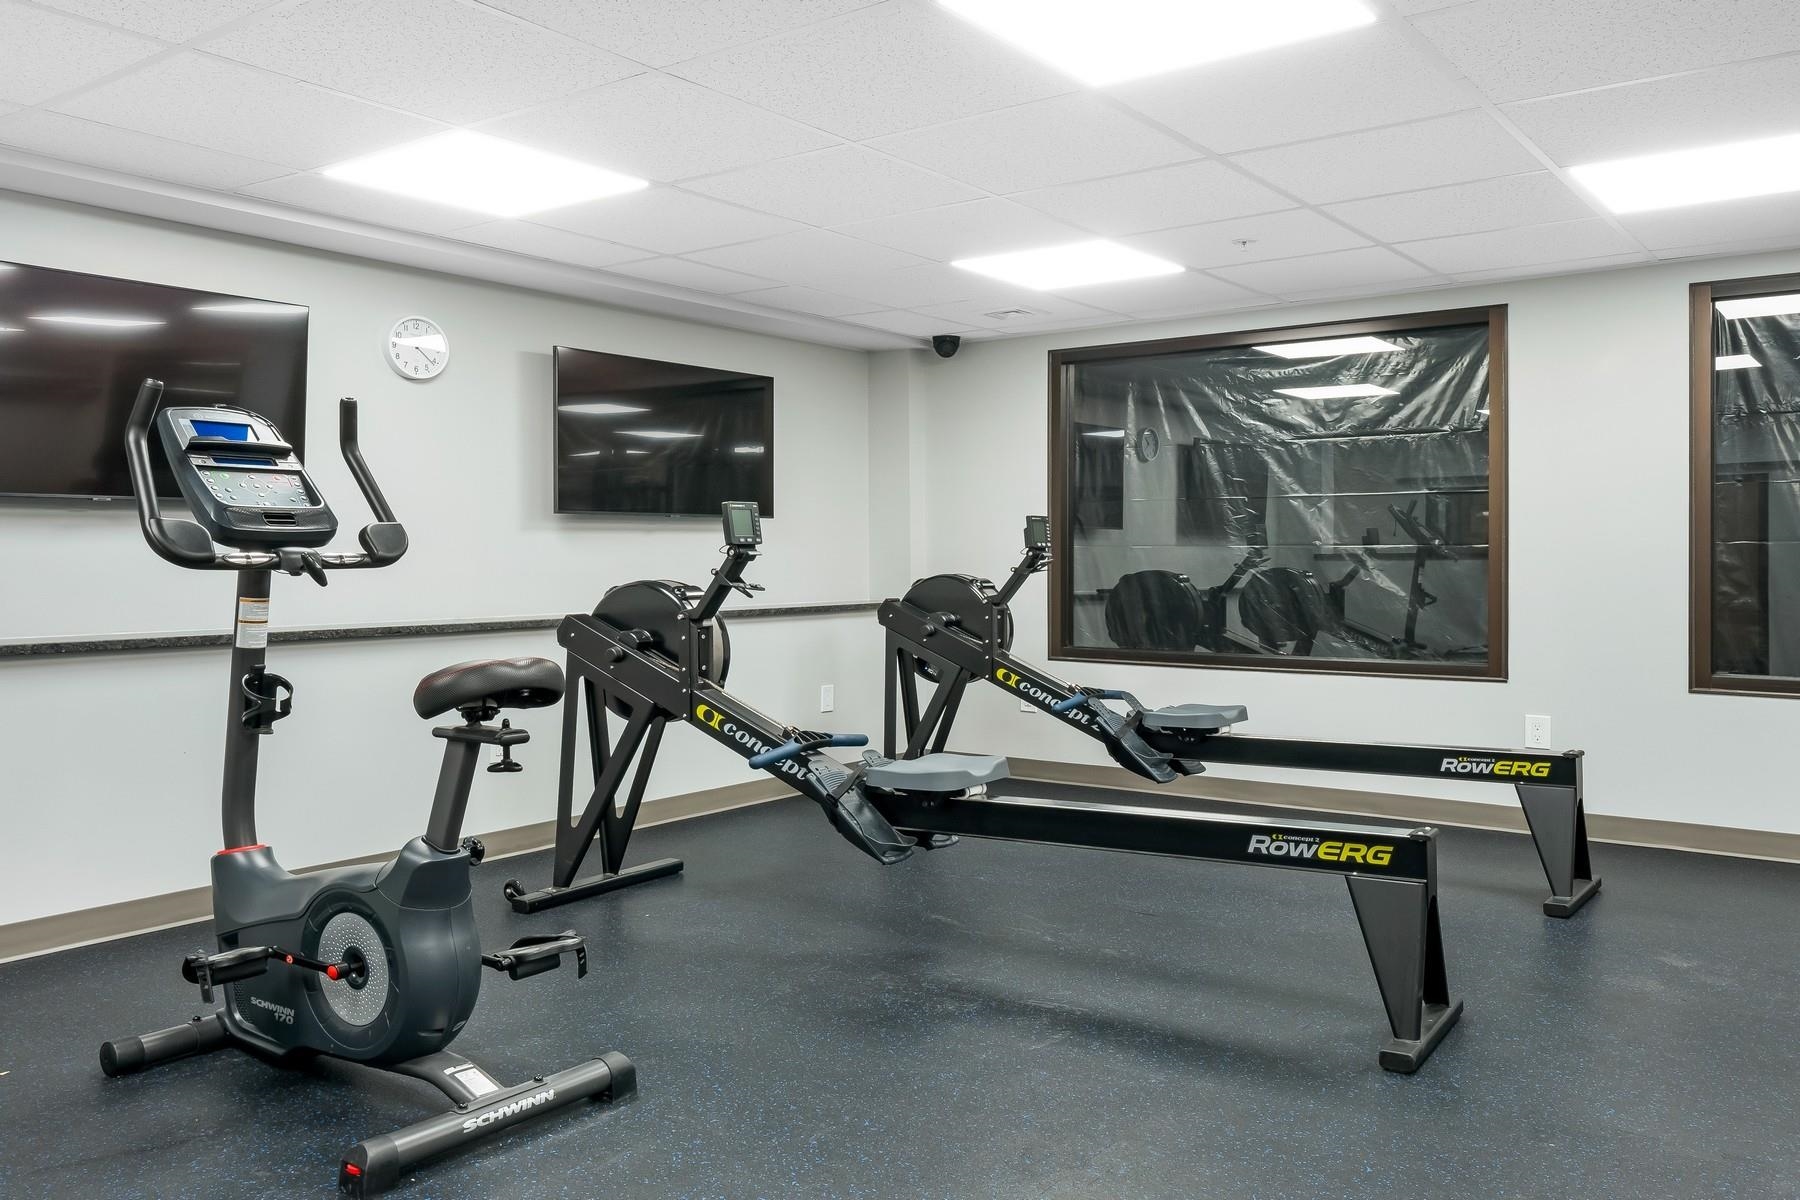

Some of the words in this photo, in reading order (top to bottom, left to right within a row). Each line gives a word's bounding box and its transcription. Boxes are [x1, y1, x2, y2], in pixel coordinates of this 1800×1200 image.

[1019, 682, 1091, 725] concpt
[723, 723, 806, 780] concpt
[1247, 834, 1394, 865] RowERG
[1283, 834, 1315, 843] concept
[250, 996, 295, 1017] SCHWINN
[274, 1013, 294, 1024] 170
[462, 1089, 555, 1133] SCHWINN
